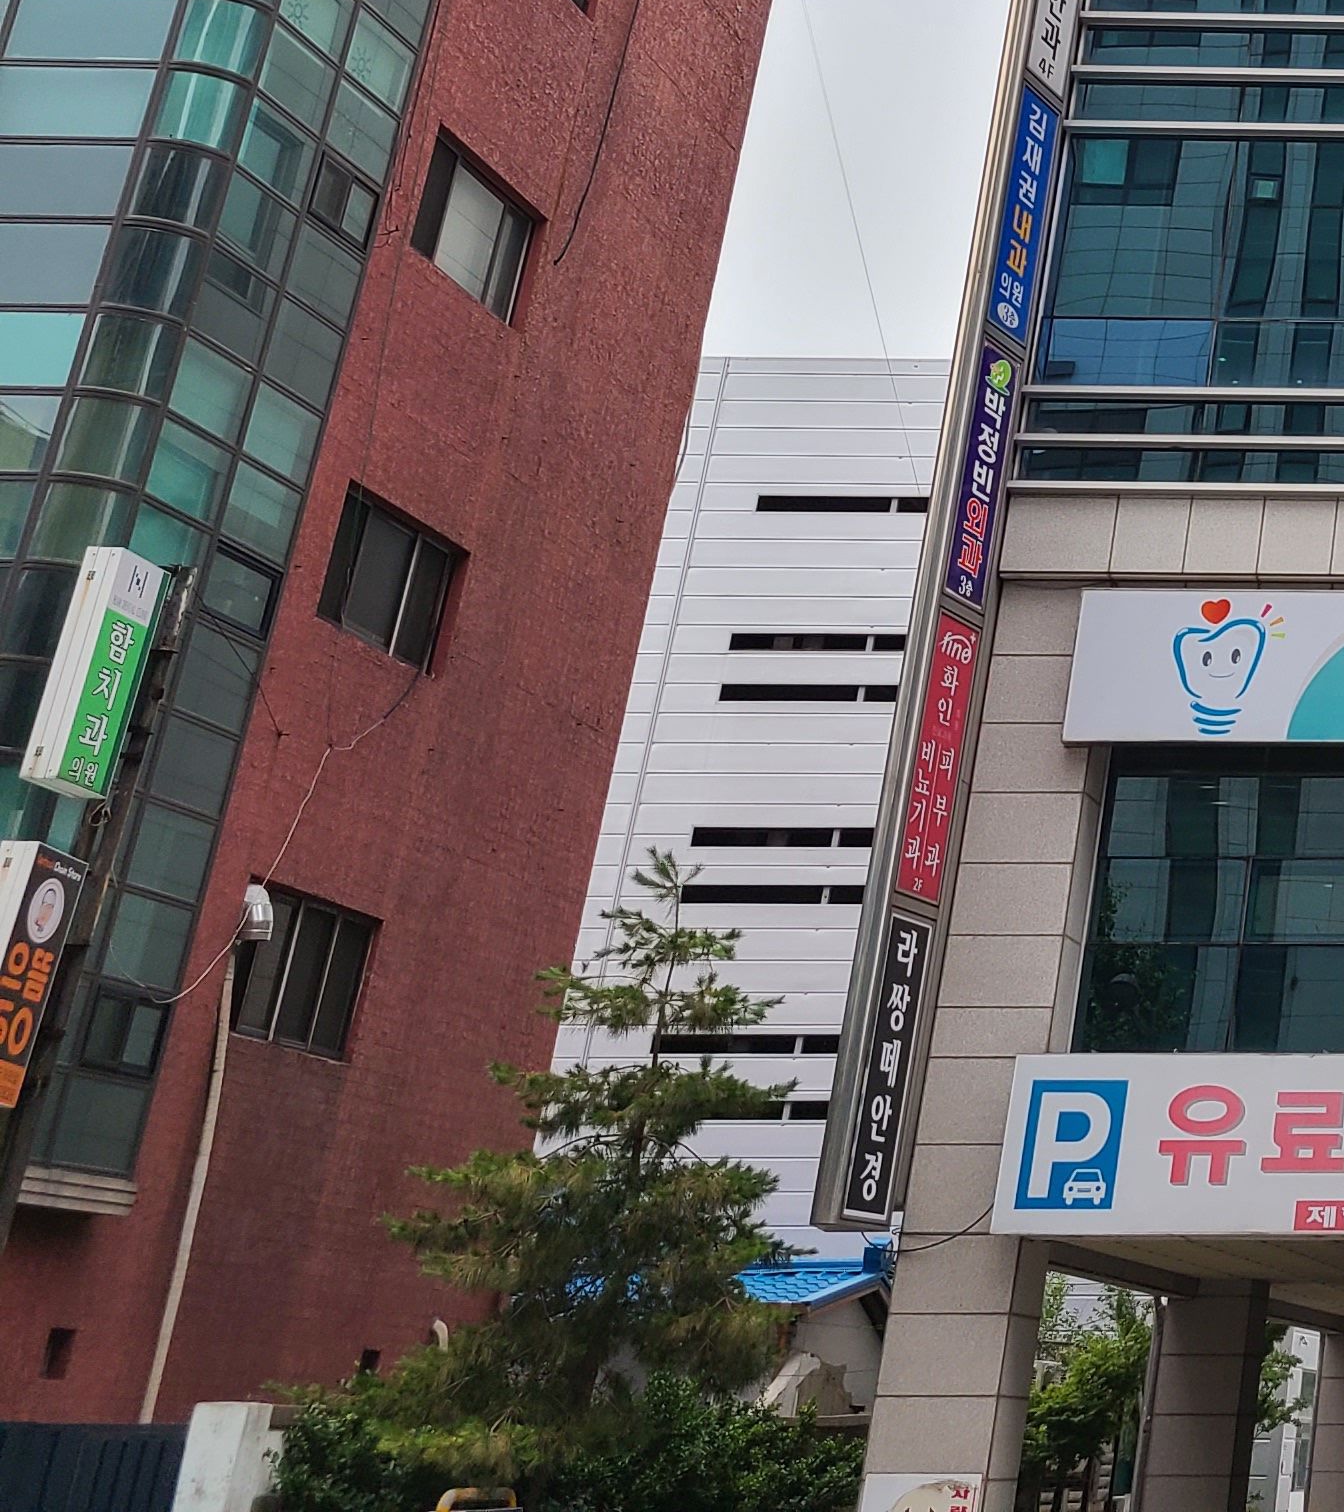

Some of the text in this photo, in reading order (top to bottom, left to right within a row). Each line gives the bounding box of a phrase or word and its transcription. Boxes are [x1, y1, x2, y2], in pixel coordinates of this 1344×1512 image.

[1038, 57, 1054, 80] 4F
[957, 387, 1006, 579] 박정빈외과
[78, 620, 134, 758] 함치과
[936, 665, 961, 729] 화인
[904, 739, 936, 873] 비뇨기과
[925, 746, 955, 878] 피부과
[858, 928, 919, 1202] 라쌍떼안경
